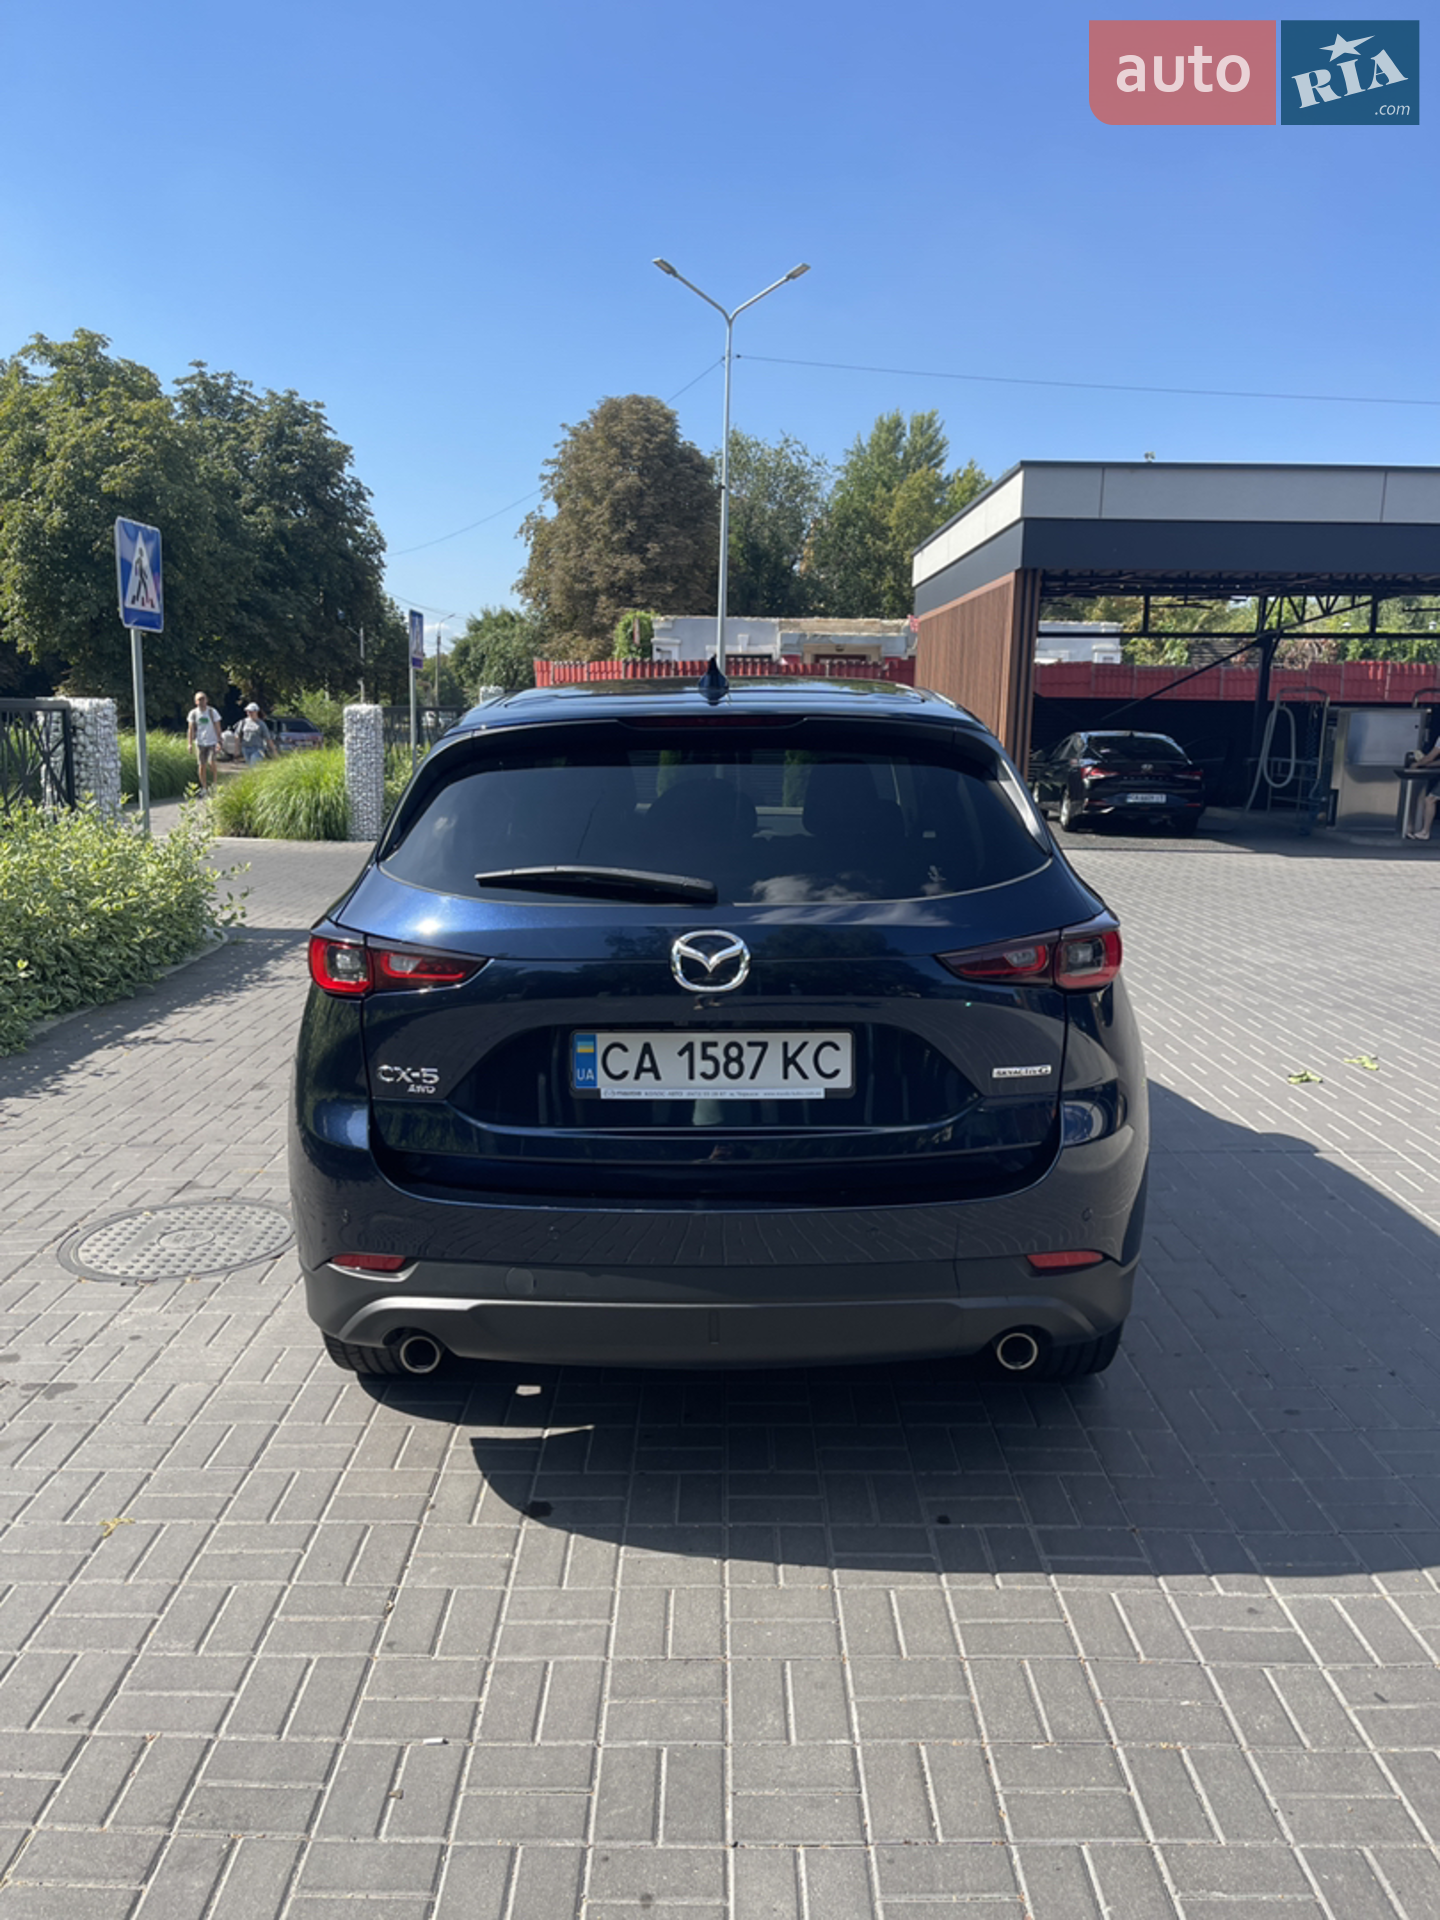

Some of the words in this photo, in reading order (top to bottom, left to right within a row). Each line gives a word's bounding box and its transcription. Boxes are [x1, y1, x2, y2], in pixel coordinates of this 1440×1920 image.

[600, 1041, 661, 1081] CA
[677, 1041, 769, 1081] 1587
[782, 1041, 841, 1080] KC
[377, 1064, 440, 1084] CX-5
[576, 1068, 595, 1081] UA
